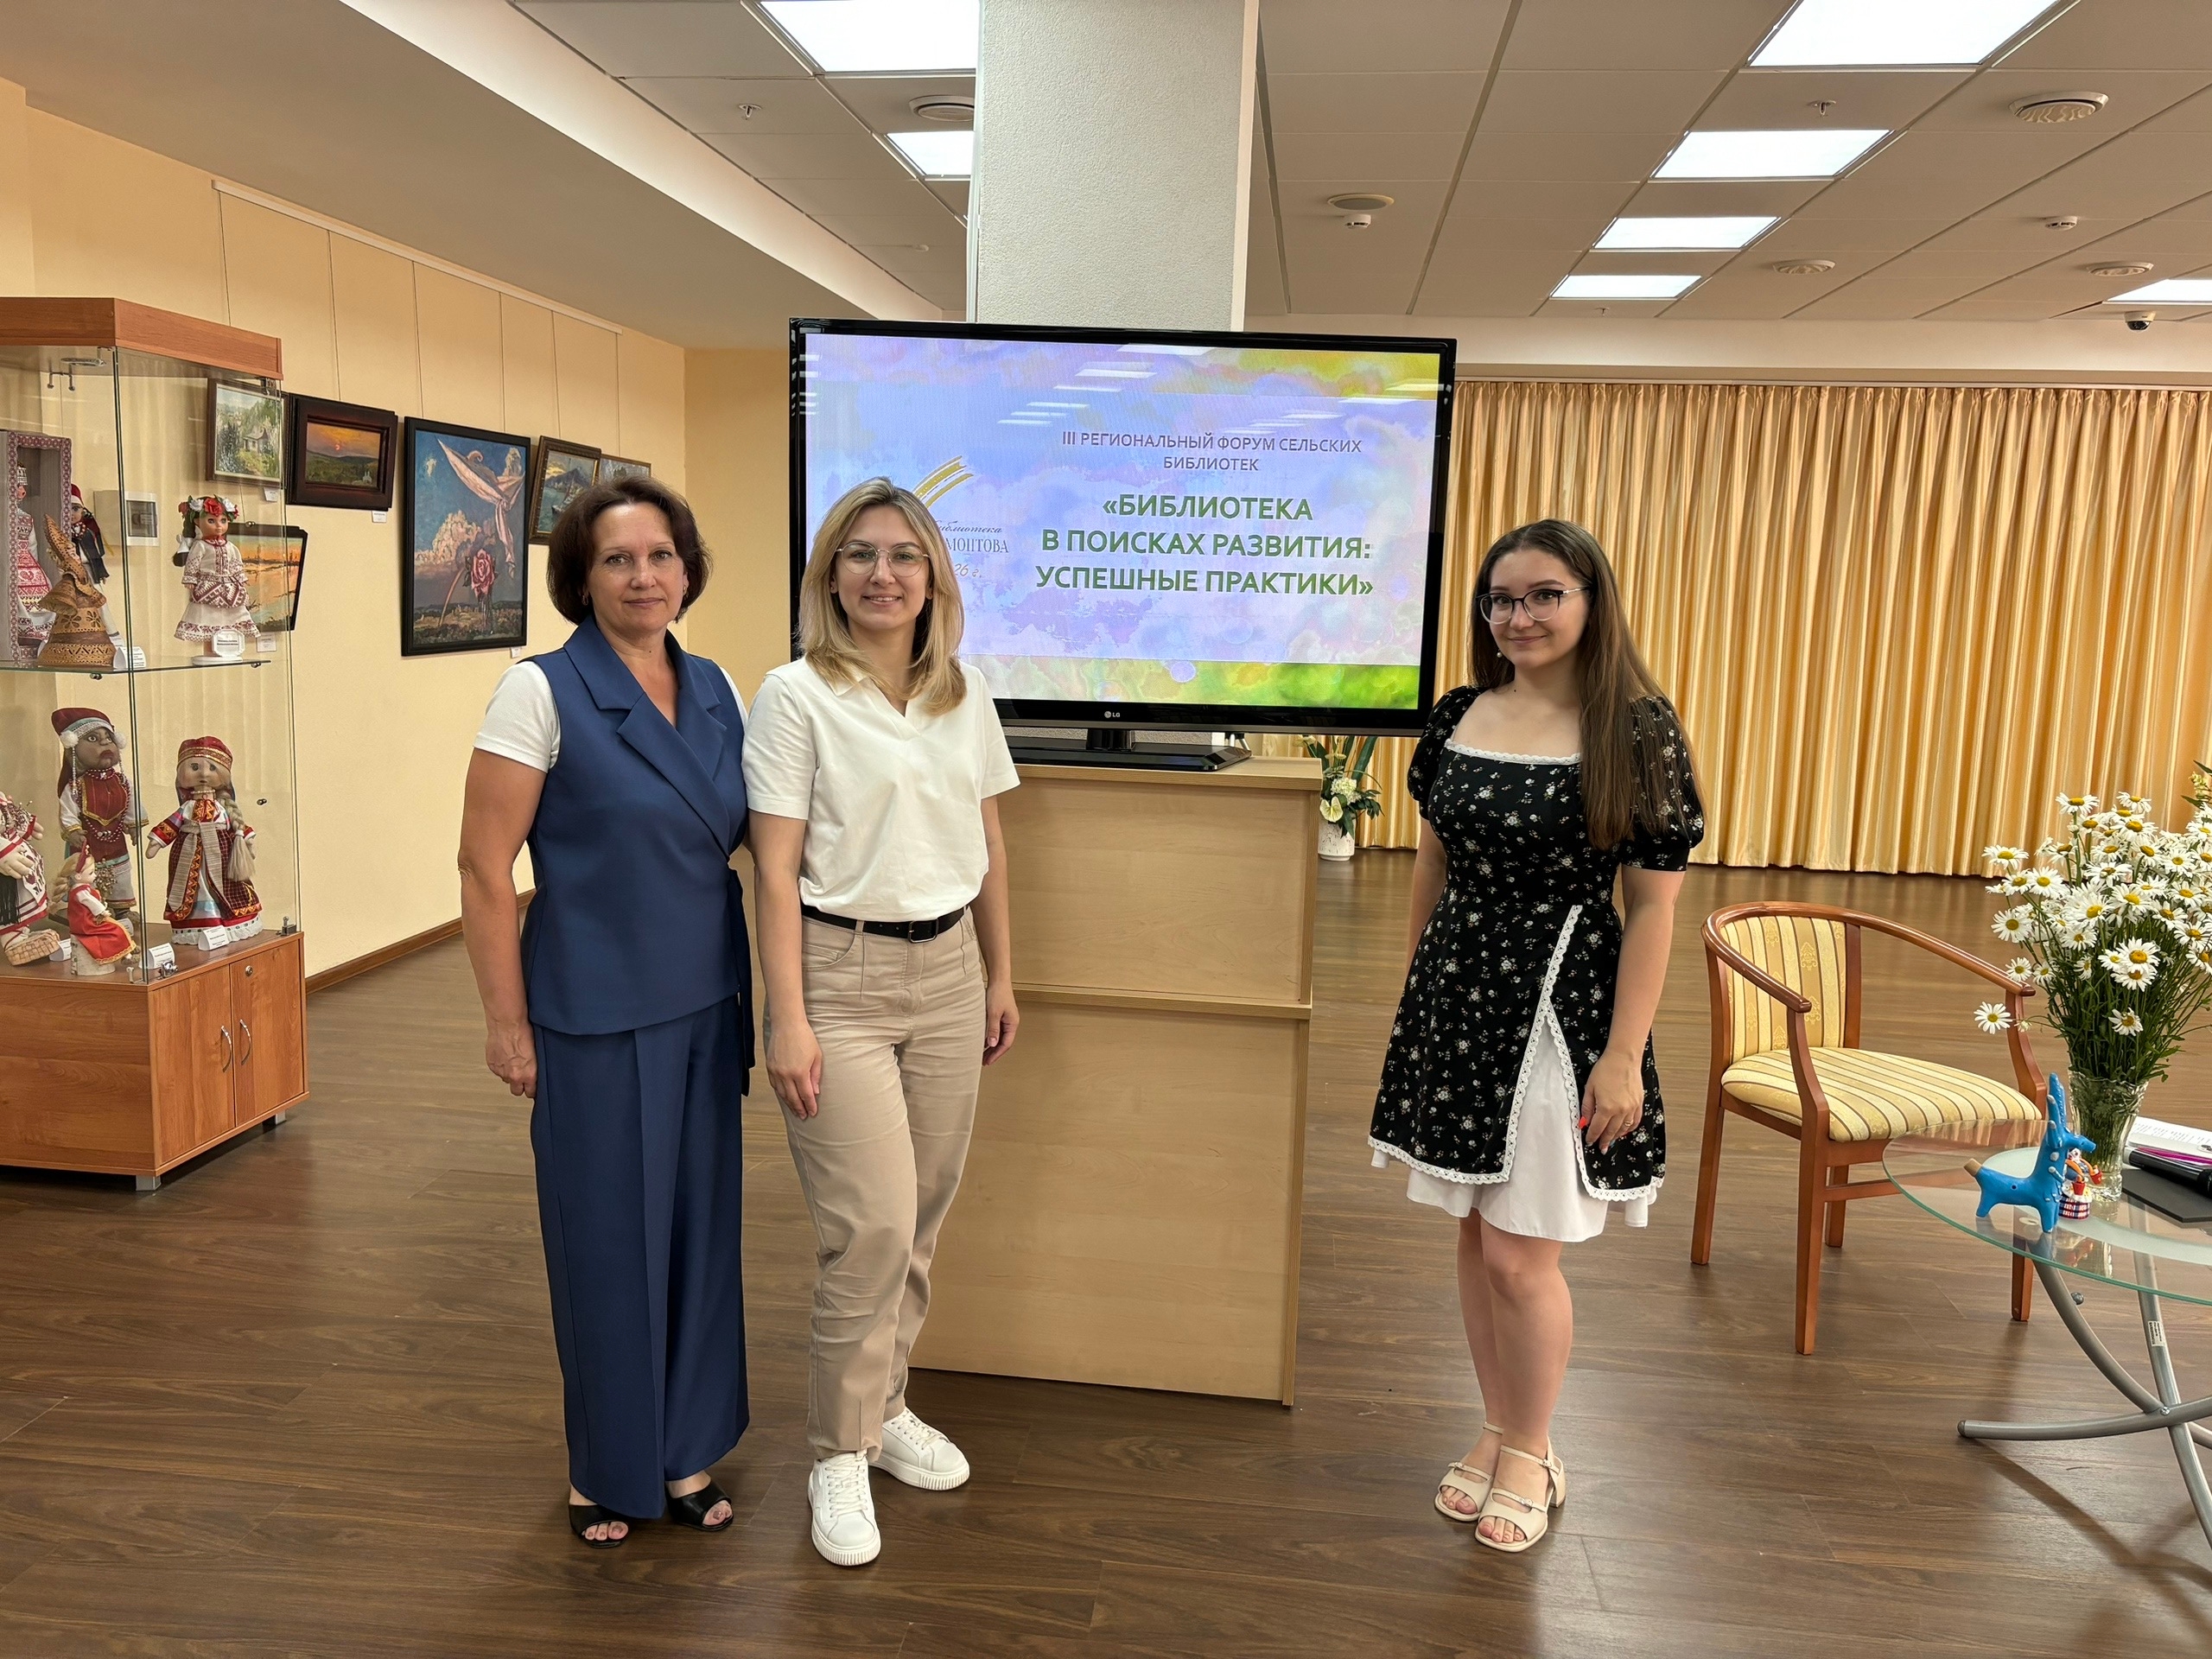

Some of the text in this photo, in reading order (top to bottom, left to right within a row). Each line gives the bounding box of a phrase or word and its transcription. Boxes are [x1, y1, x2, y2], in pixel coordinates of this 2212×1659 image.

[1062, 431, 1363, 453] III РЕГИОНАЛЬНЫЙ ФОРУМ СЕЛЬСКИХ
[1163, 456, 1259, 471] БИБЛИОТЕК
[1103, 493, 1313, 520] «БИБЛИОТЕКА
[936, 520, 1002, 533] иблиотека
[1042, 529, 1371, 559] В ПОИСКАХ РАЗВИТИЯ:
[1035, 565, 1374, 595] УСПЕШНЫЕ ПРАКТИКИ»
